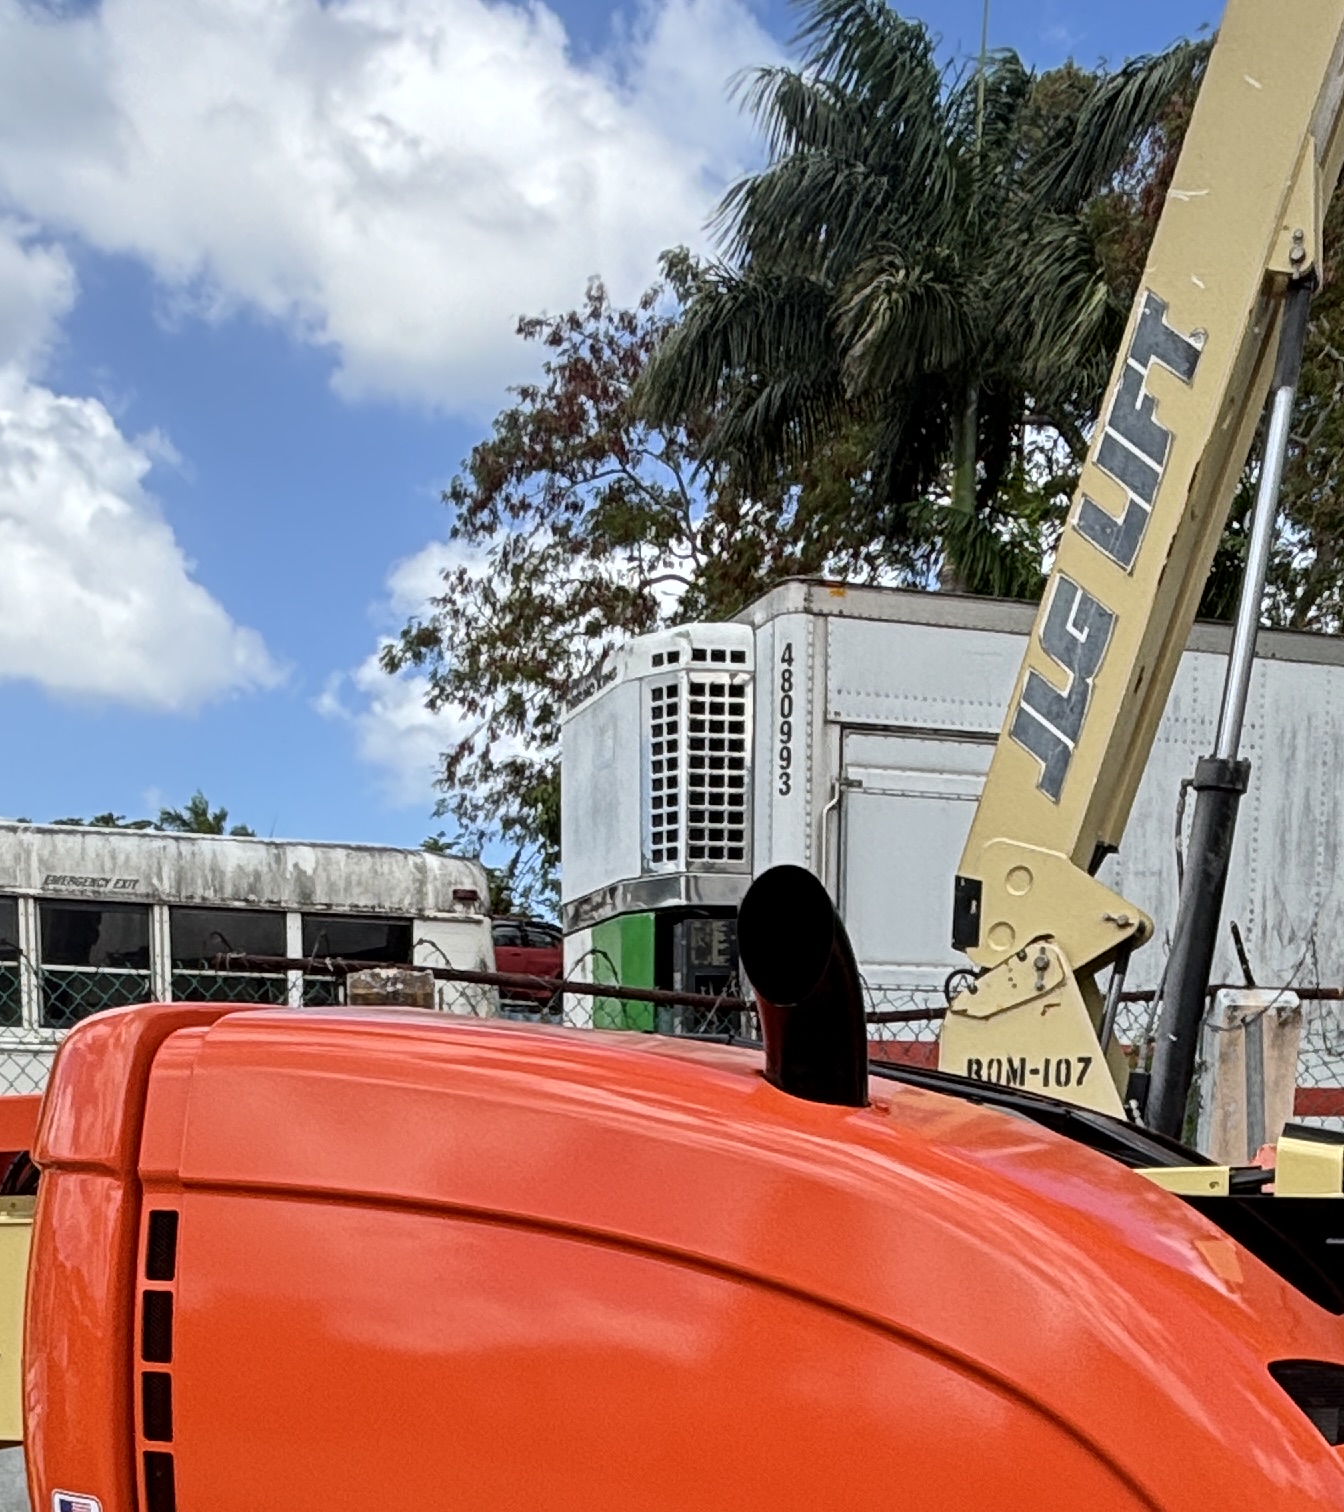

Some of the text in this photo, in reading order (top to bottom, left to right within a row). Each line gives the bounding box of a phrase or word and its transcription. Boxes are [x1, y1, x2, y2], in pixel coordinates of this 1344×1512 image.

[1009, 287, 1209, 806] JLG LIFT
[778, 642, 795, 796] 480993
